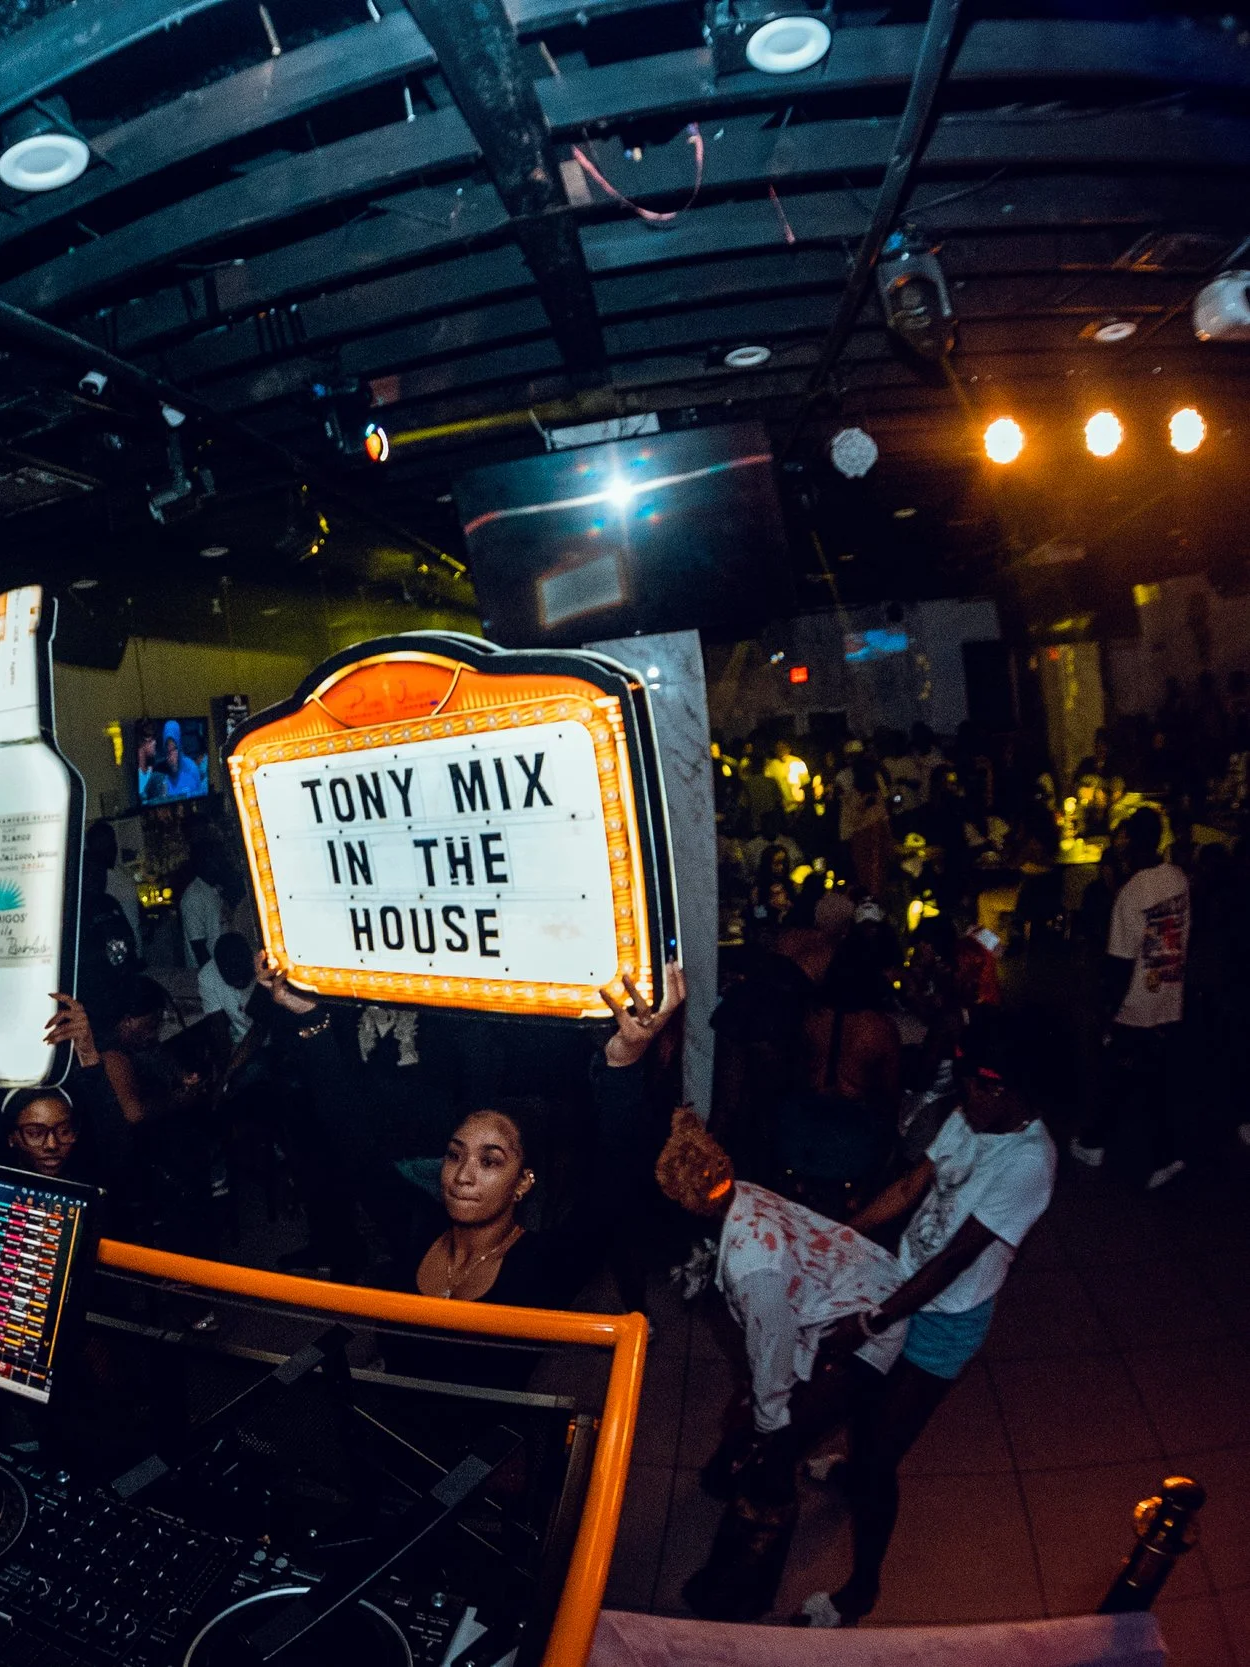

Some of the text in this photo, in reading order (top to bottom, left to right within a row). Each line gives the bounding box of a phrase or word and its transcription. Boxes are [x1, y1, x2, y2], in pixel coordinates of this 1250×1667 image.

[301, 751, 554, 825] TONY MIX
[327, 832, 509, 887] IN THE
[349, 905, 502, 959] HOUSE
